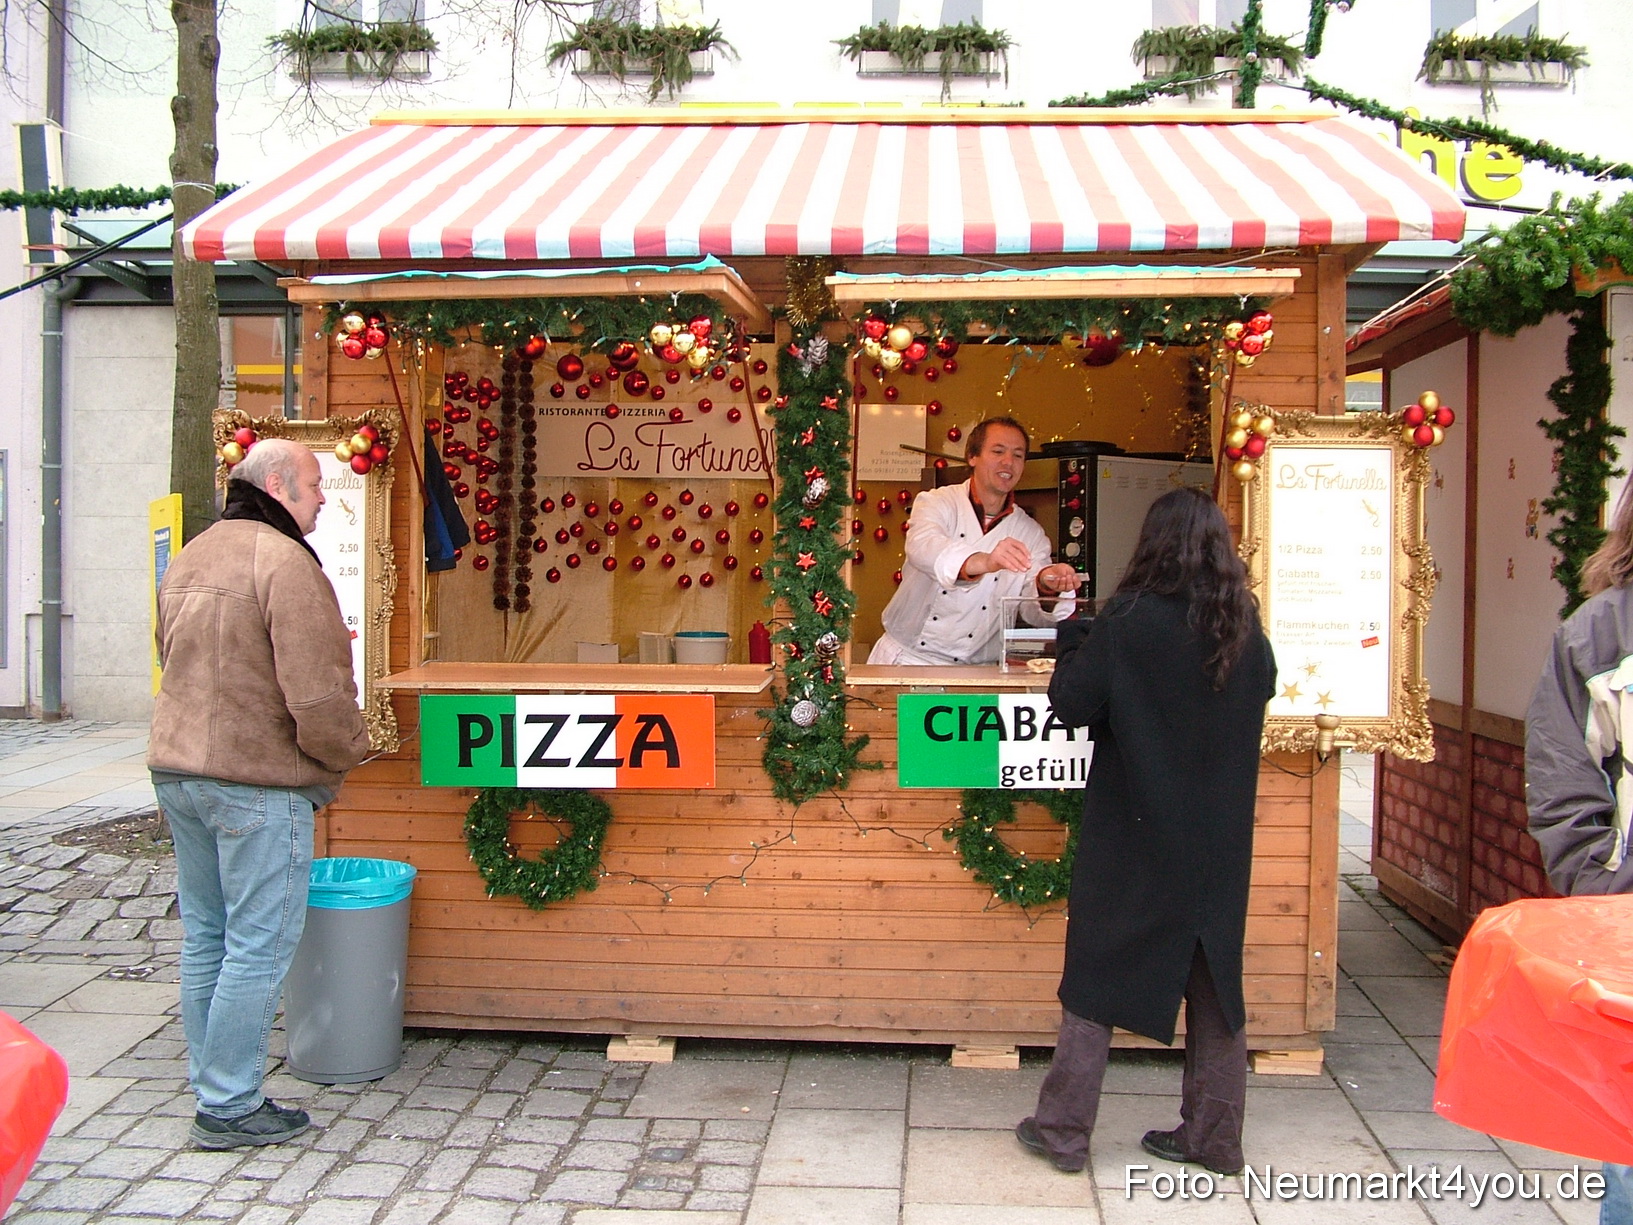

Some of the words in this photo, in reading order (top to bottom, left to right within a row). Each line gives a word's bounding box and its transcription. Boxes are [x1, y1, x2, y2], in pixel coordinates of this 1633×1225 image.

[538, 407, 605, 416] RISTORANTE
[617, 408, 666, 417] PIZZERIA
[577, 421, 640, 471] La
[635, 419, 775, 474] Fortunell
[320, 468, 363, 490] unella
[1276, 464, 1308, 489] La
[1304, 463, 1388, 491] Fortunella
[339, 543, 359, 553] 2,50
[1278, 544, 1293, 554] 1/2
[1295, 545, 1323, 555] Pizza
[339, 567, 359, 577] 2,50
[1277, 568, 1320, 579] Ciabatta
[1276, 619, 1350, 630] Flammkuchen
[923, 705, 1095, 742] CIABA
[456, 713, 681, 769] PIZZA
[1000, 757, 1087, 788] gefüll
